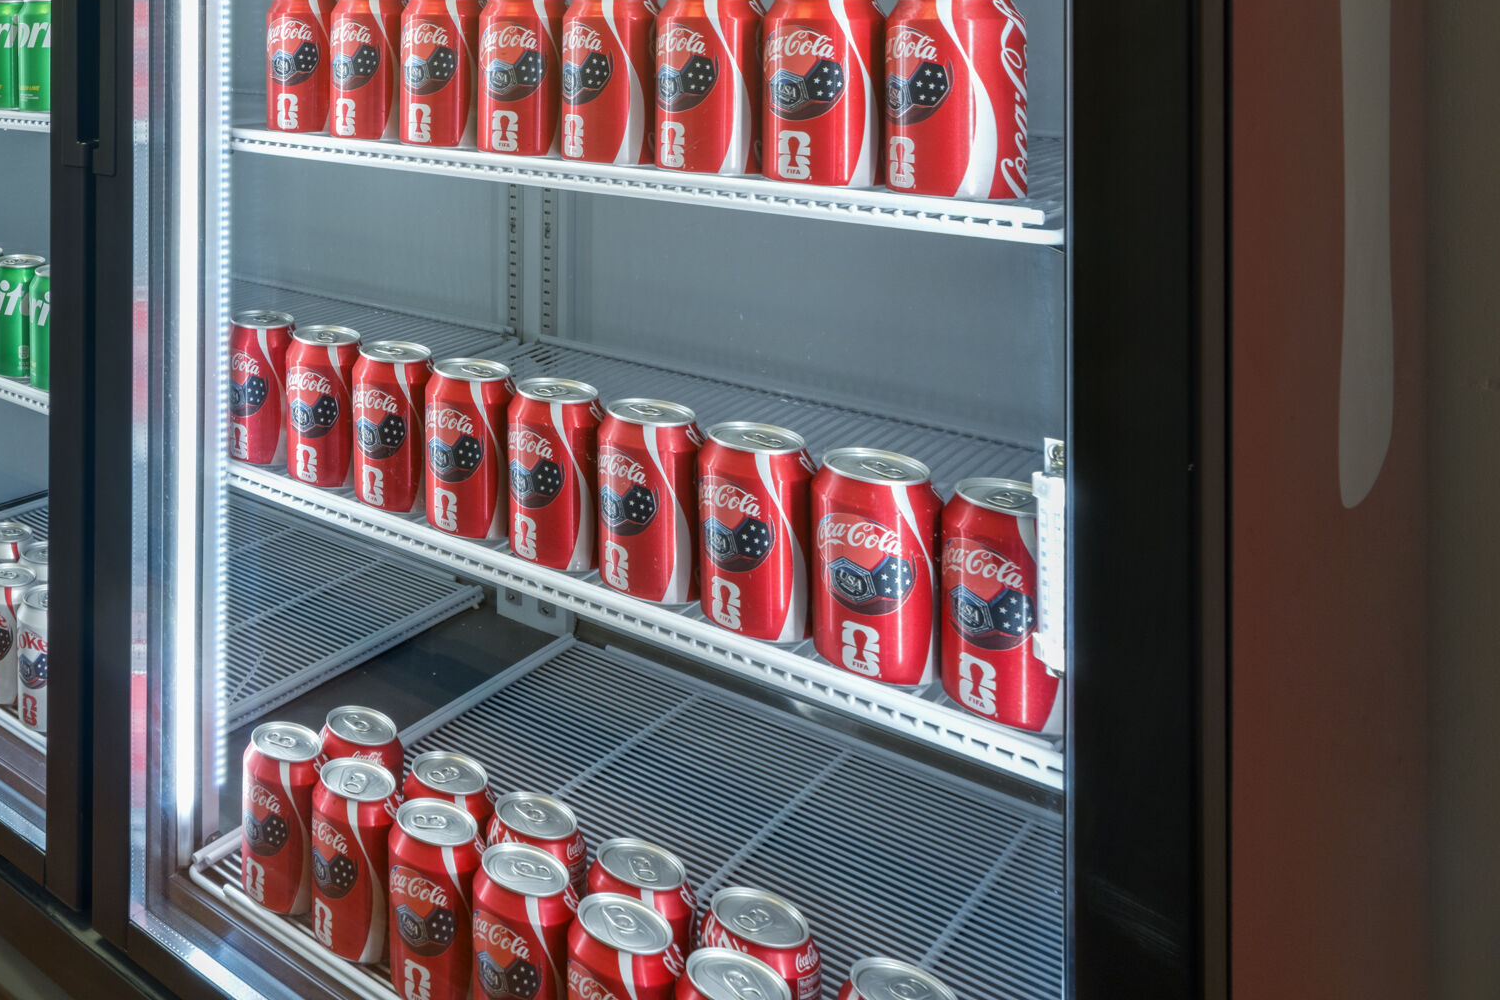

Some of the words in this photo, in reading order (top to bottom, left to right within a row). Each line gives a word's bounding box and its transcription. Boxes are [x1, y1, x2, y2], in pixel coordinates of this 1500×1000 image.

[838, 568, 863, 591] USA
[18, 631, 49, 652] oke
[852, 662, 870, 672] FIFA
[968, 697, 986, 708] FIFA
